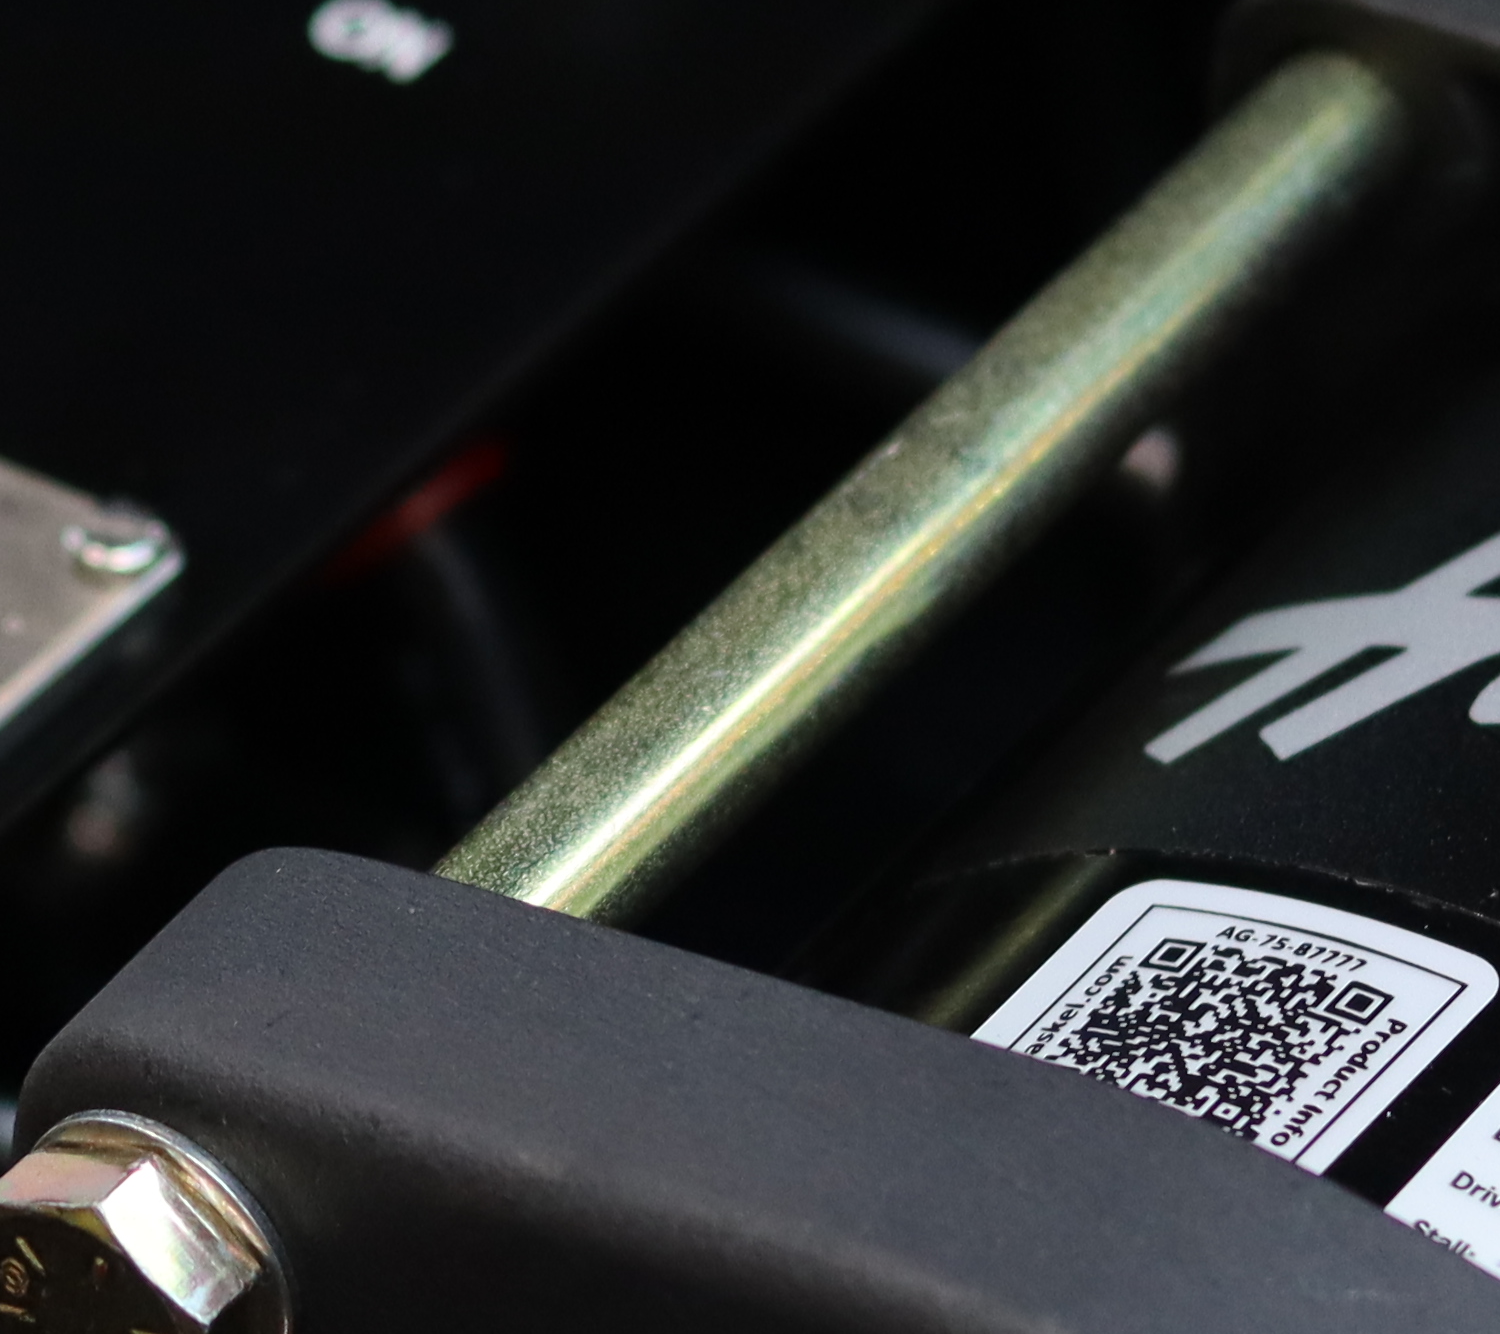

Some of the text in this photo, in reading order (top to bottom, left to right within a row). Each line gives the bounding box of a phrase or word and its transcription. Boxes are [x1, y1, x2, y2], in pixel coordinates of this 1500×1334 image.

[1216, 926, 1367, 972] AG-75-87777
[1271, 1019, 1407, 1147] Product Info
